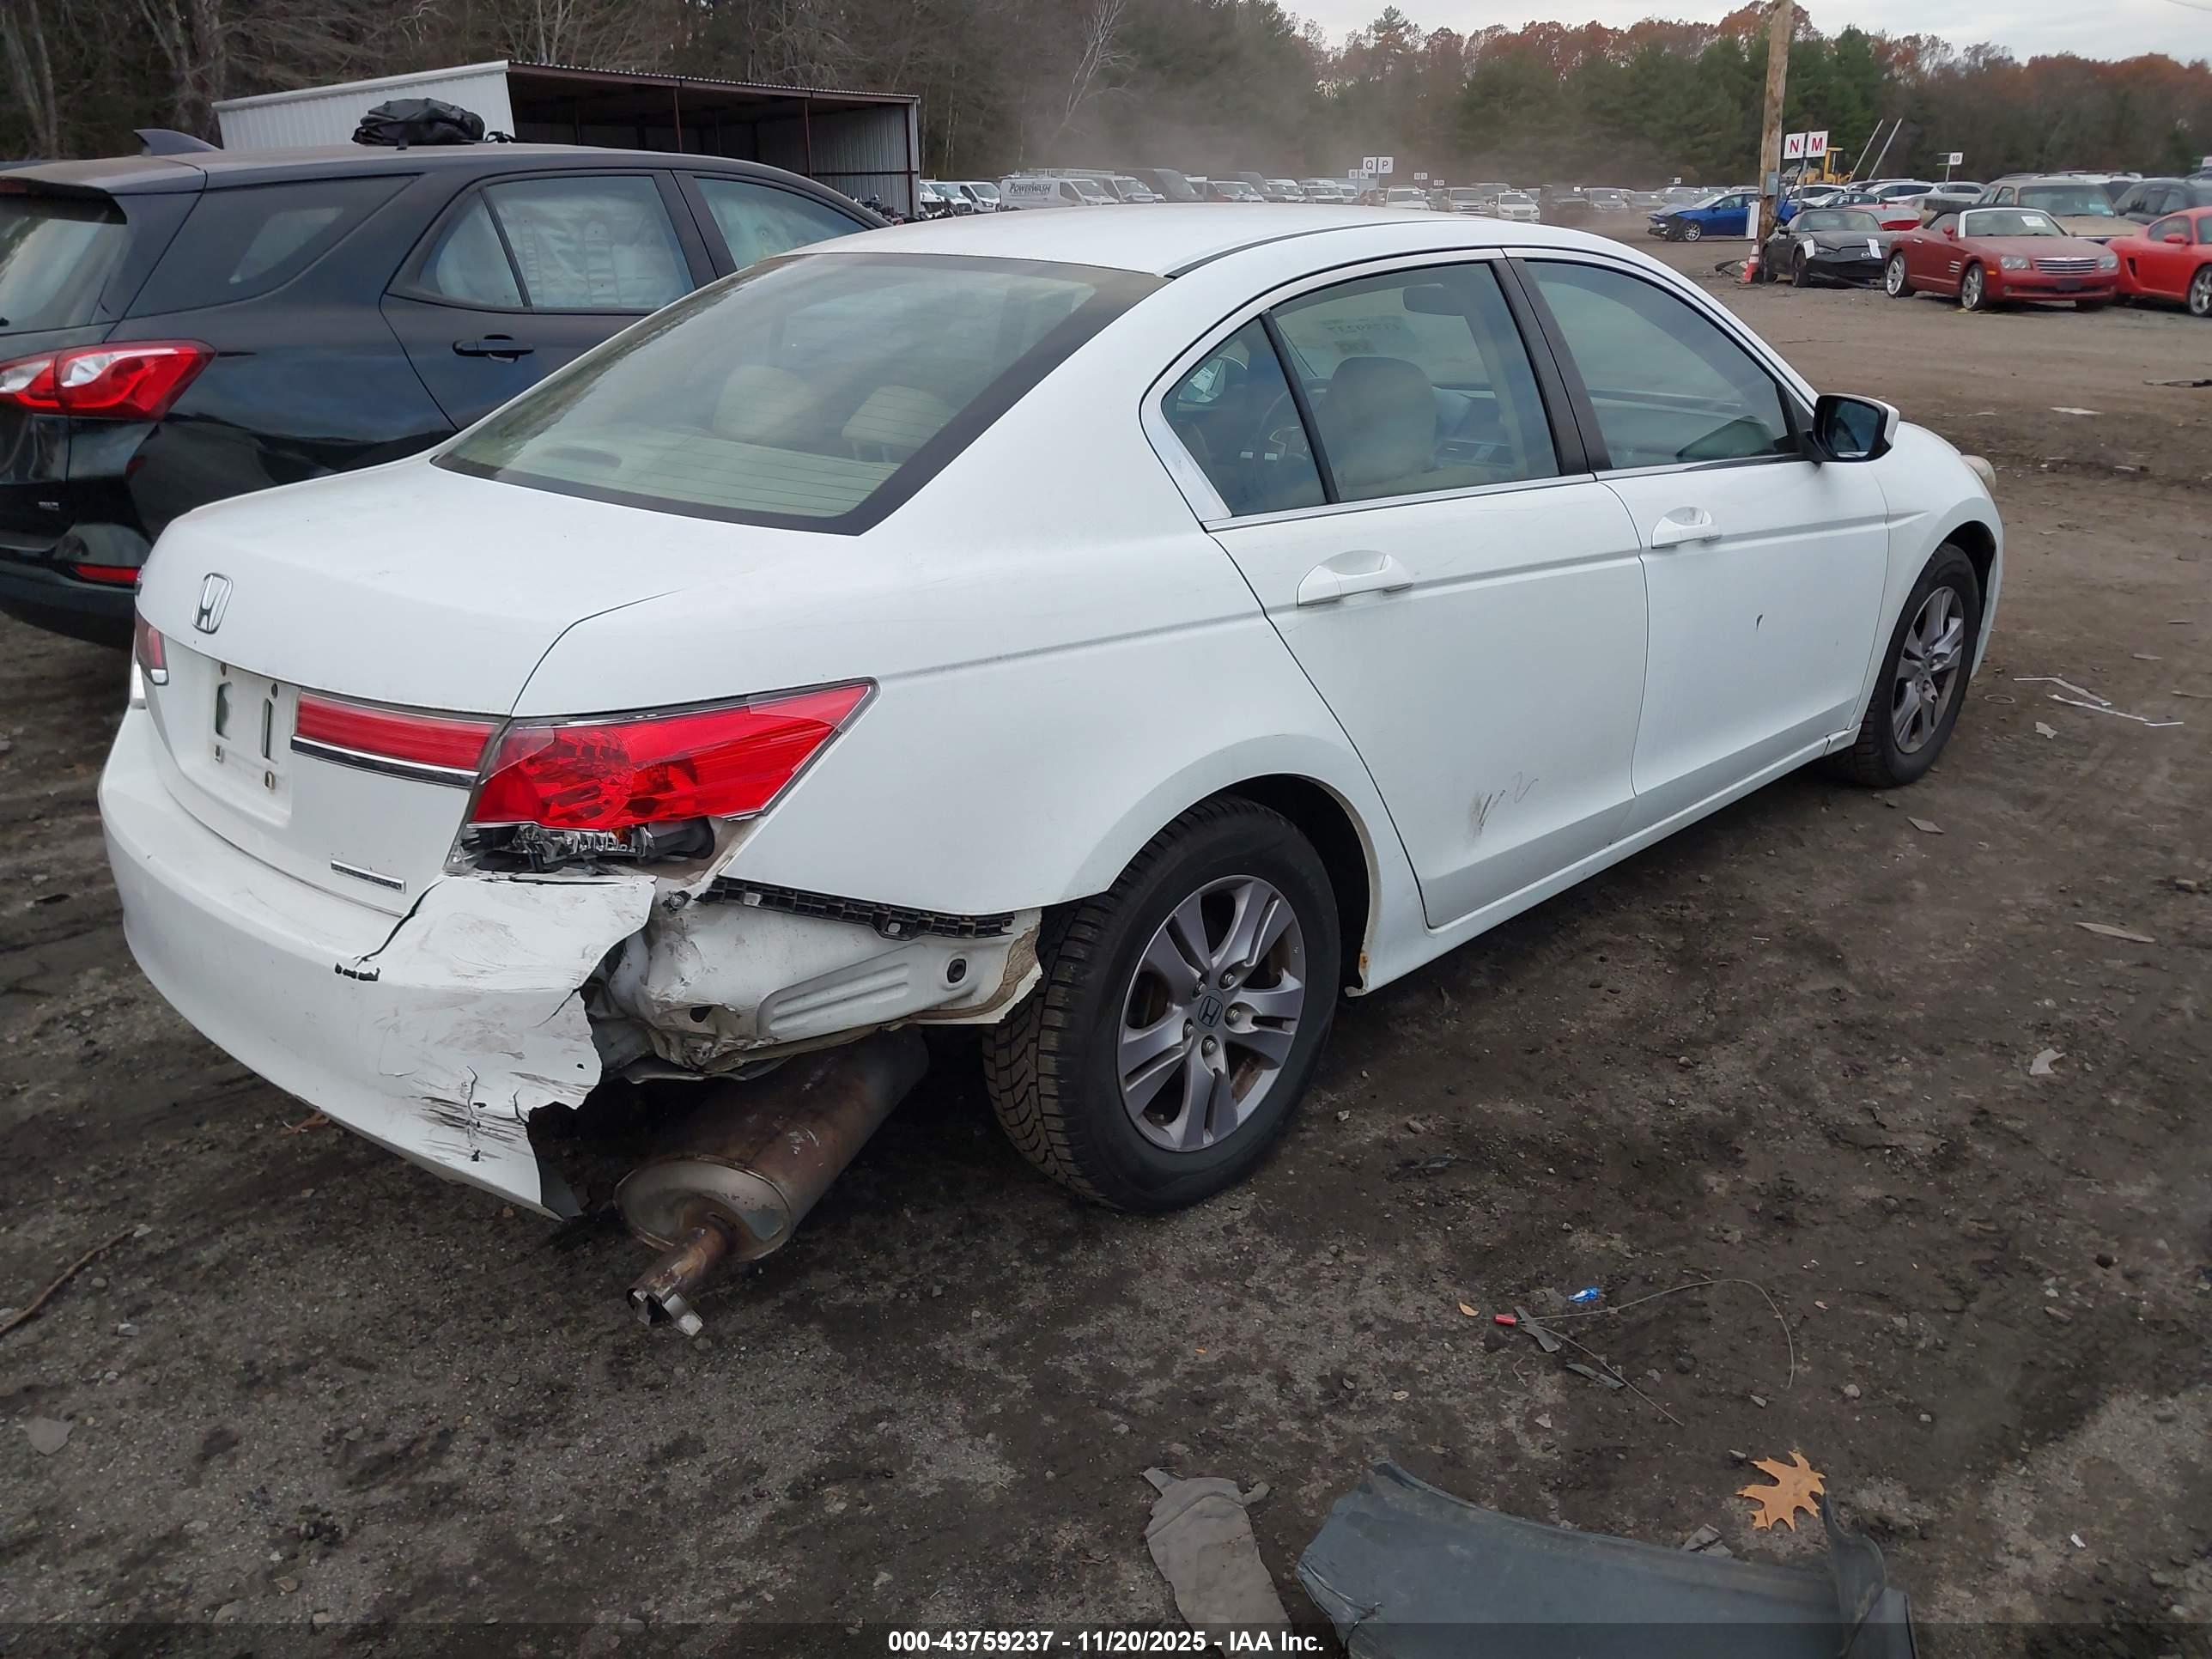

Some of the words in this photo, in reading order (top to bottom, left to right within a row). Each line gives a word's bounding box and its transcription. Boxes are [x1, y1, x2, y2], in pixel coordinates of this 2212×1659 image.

[1790, 139, 1800, 153] N
[1811, 137, 1823, 152] M
[1365, 160, 1373, 170] Q
[1382, 161, 1389, 170] P
